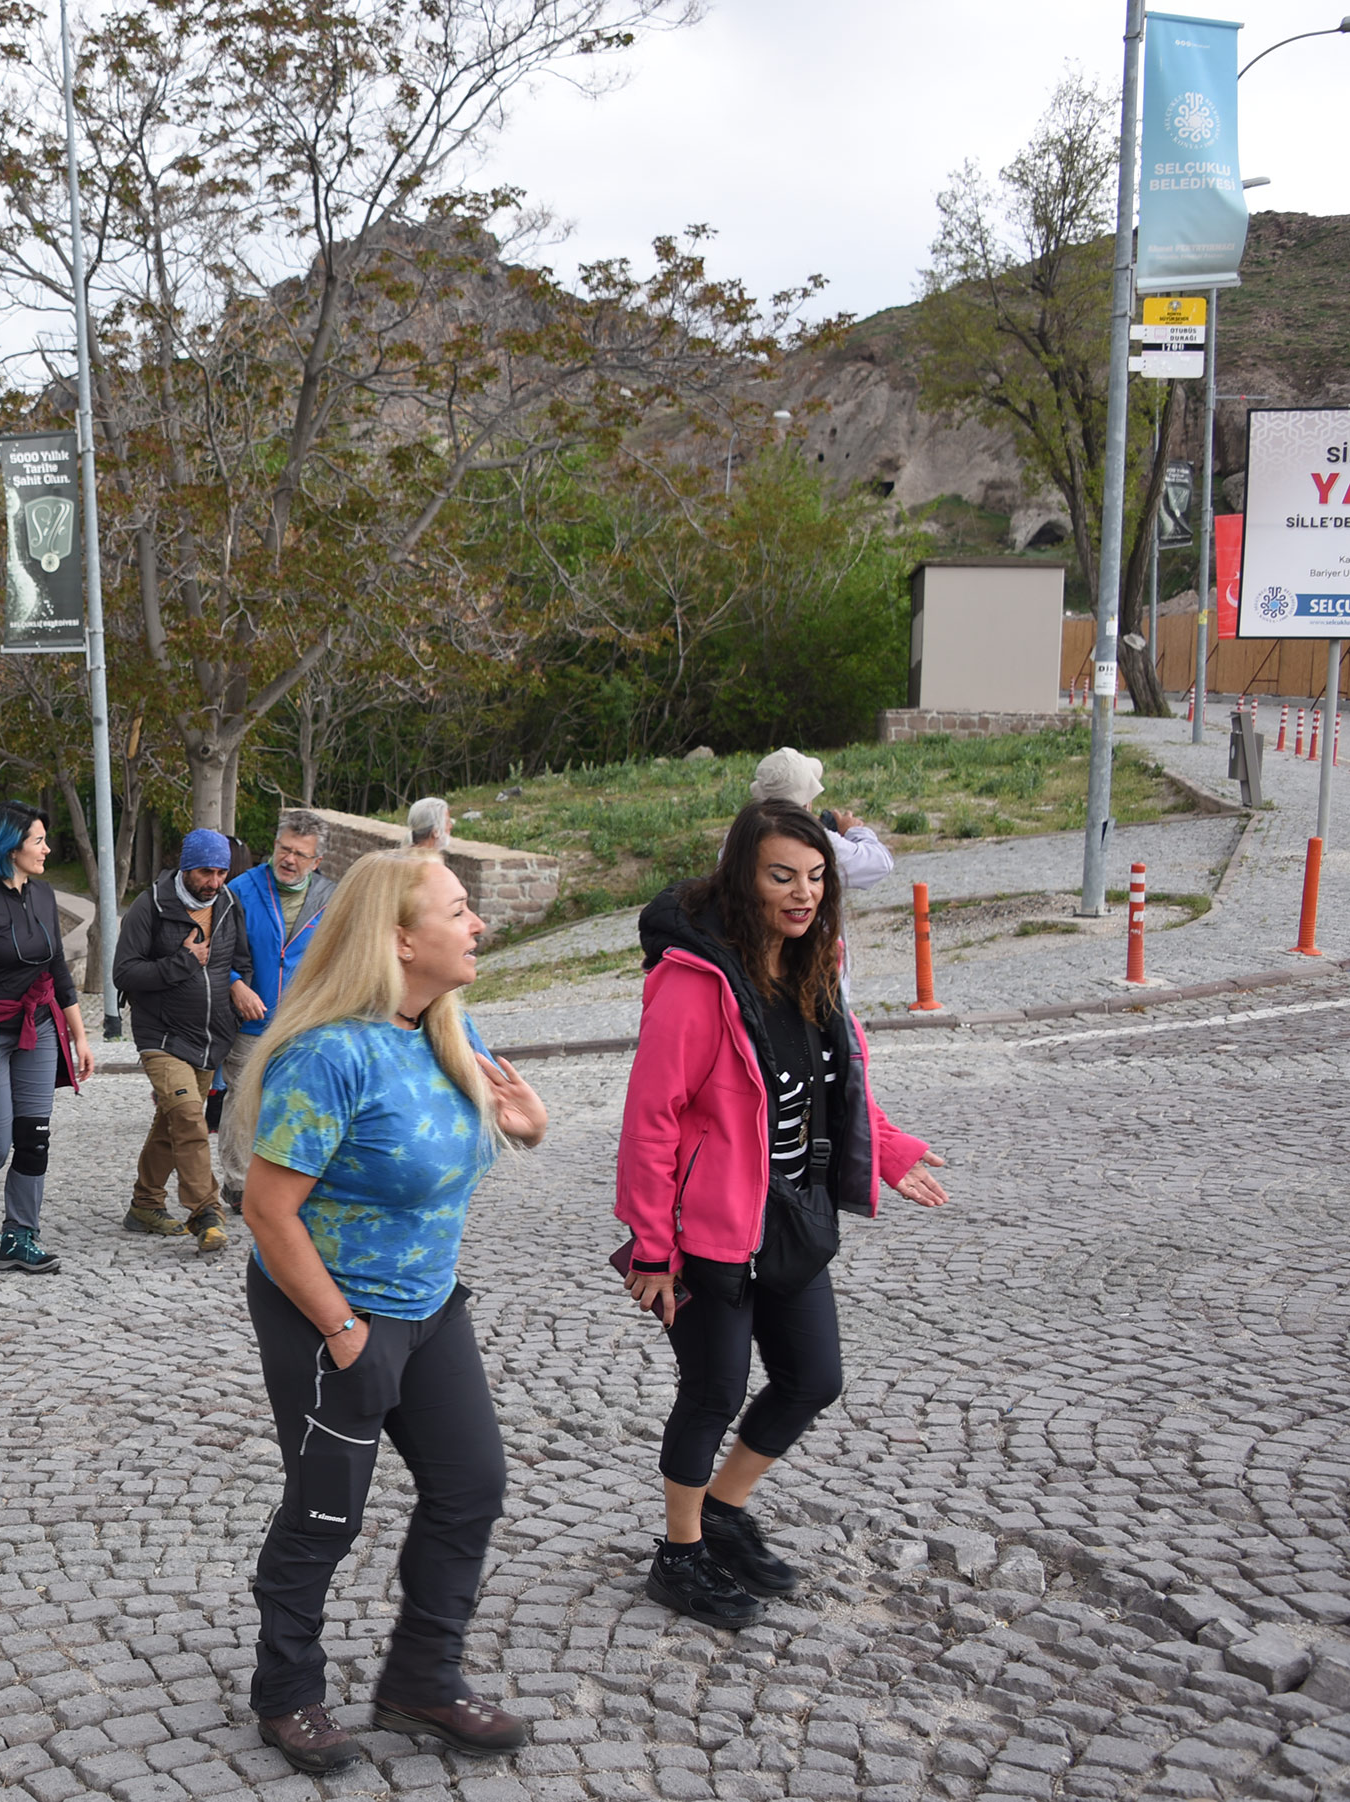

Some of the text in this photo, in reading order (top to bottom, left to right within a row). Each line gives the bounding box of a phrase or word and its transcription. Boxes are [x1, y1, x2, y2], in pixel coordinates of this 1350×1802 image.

[1154, 161, 1231, 176] SELÇUKLU
[1149, 175, 1236, 191] BELEDİYESİ
[10, 452, 39, 464] 5000
[23, 462, 58, 474] Tarihe
[13, 474, 42, 488] Şahit
[1310, 569, 1341, 579] Bariyer
